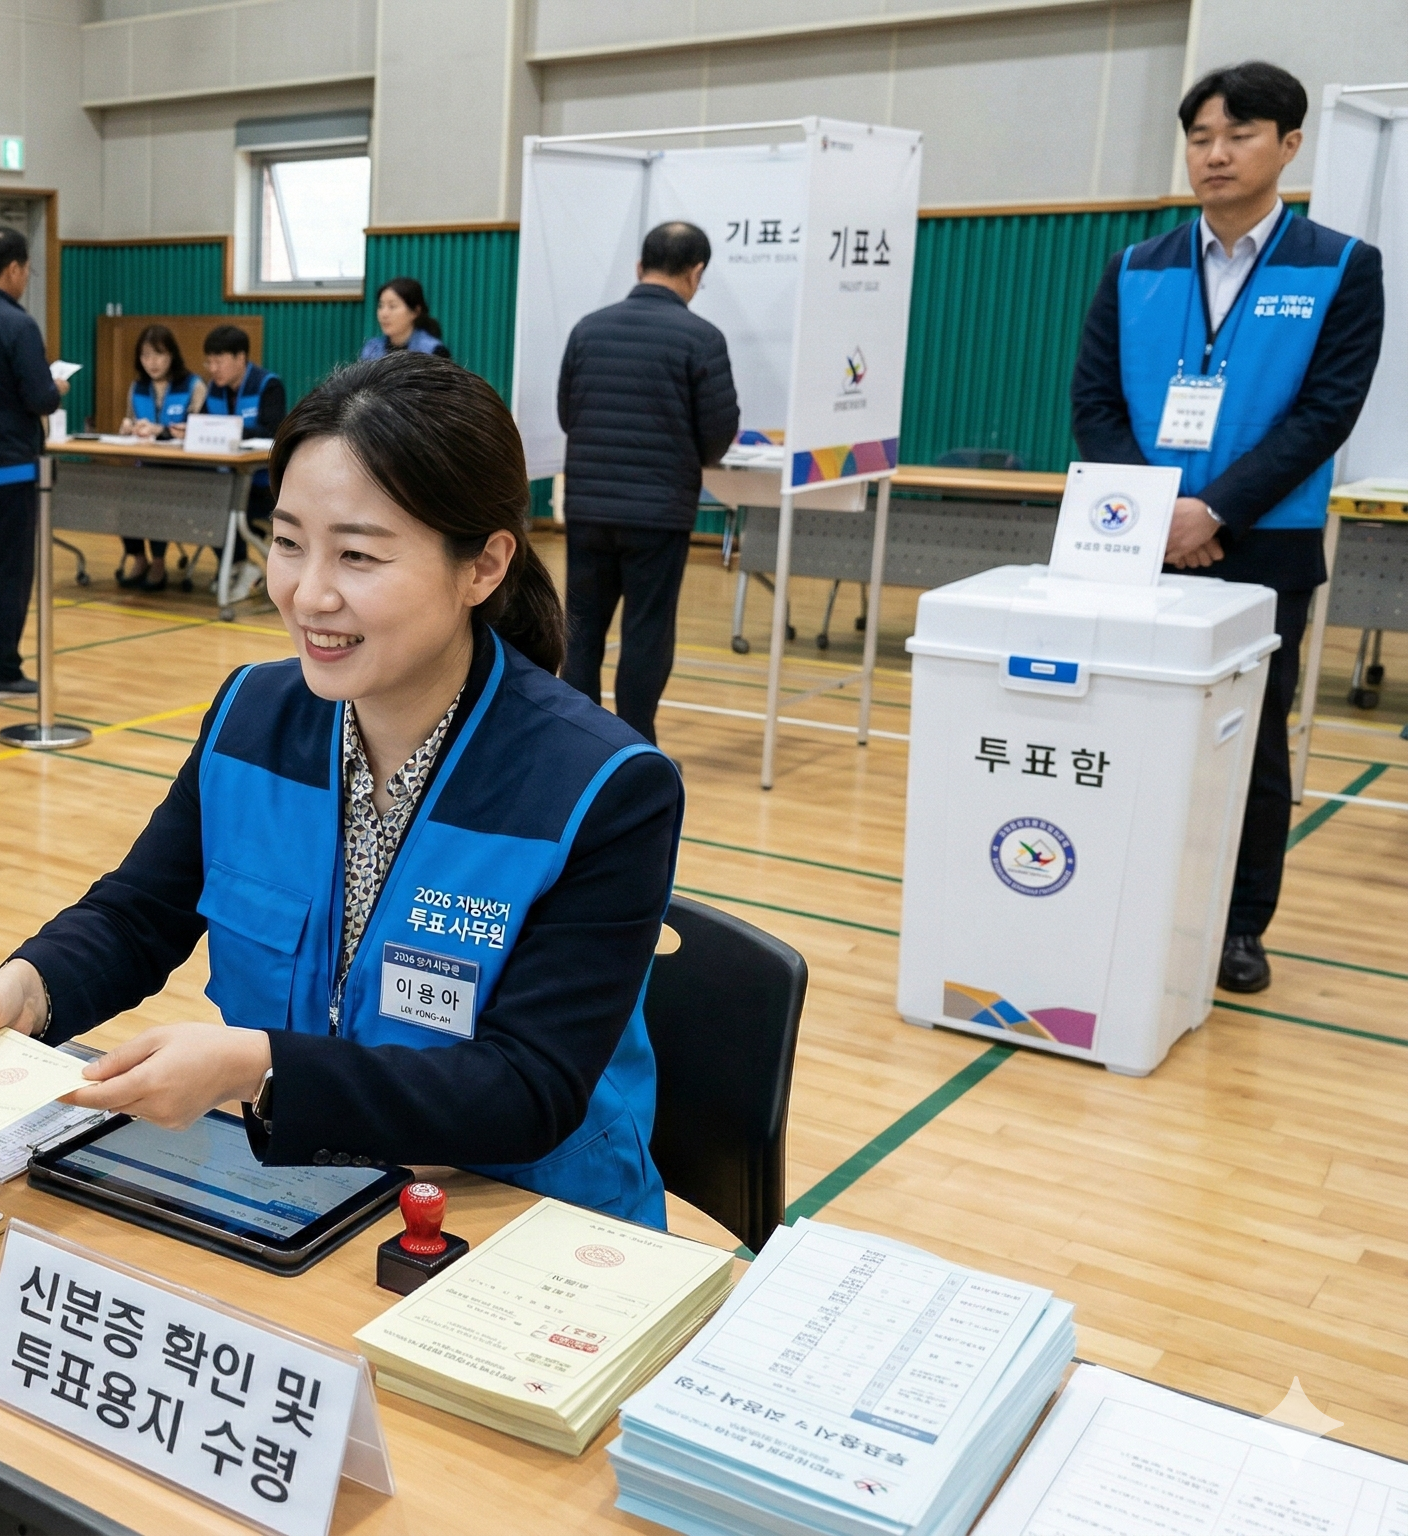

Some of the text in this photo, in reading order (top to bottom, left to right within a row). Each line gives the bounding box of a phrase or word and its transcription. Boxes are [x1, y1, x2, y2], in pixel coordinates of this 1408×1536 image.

[829, 226, 891, 268] 기표소
[975, 736, 1110, 788] 투표함
[414, 887, 452, 909] 2026
[407, 907, 506, 949] 투표 사무원
[396, 978, 460, 1011] 이용아
[20, 1265, 322, 1438] 신분증 확인 및
[11, 1331, 298, 1503] 투표용지 수령
